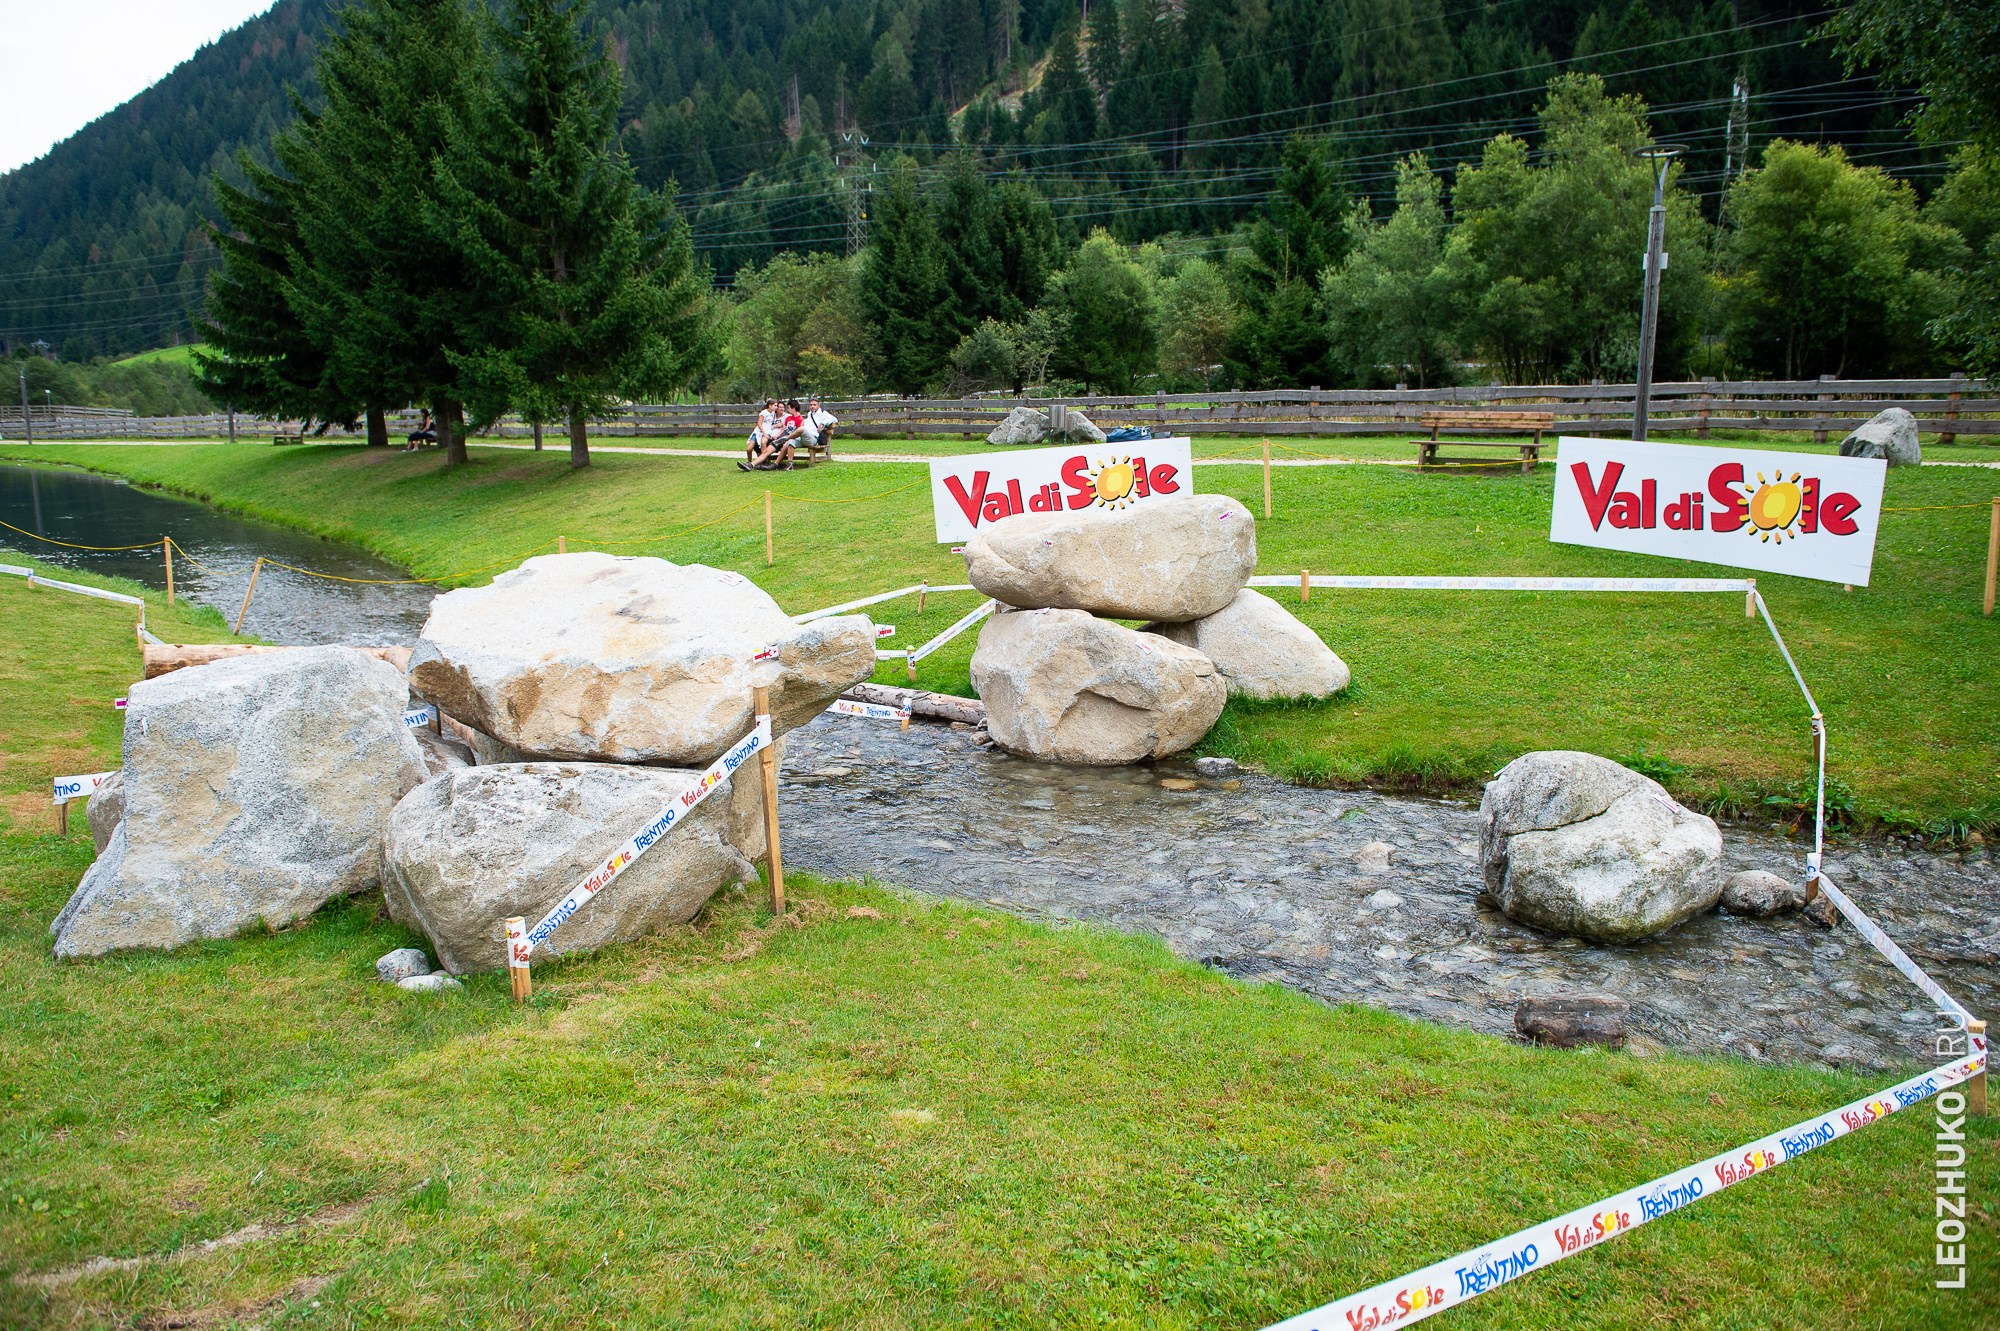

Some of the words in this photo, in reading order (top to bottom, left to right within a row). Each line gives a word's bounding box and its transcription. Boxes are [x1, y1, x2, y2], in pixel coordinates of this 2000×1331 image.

[943, 471, 1024, 528] Val
[1029, 482, 1063, 512] di
[1060, 455, 1180, 510] Sole
[1570, 461, 1657, 532] Val
[1663, 491, 1704, 531] di
[1707, 462, 1862, 543] Sole
[529, 899, 577, 945] TRENTINO
[584, 875, 602, 894] Val
[601, 872, 611, 884] di
[607, 851, 632, 877] Sole
[634, 809, 675, 851] TRENTINO
[681, 791, 697, 808] Val
[700, 770, 722, 792] Sole
[723, 736, 759, 772] TRENTINO
[1346, 1304, 1380, 1331] Val
[1395, 1284, 1445, 1320] Sole
[1455, 1243, 1539, 1298] TRENTINO
[1555, 1223, 1581, 1254] Val
[1582, 1225, 1595, 1246] di
[1592, 1207, 1631, 1241] Sole
[1637, 1176, 1703, 1222] TRENTINO
[1715, 1161, 1738, 1188] Val
[1738, 1162, 1748, 1178] di
[1744, 1149, 1776, 1176] Sole
[1779, 1121, 1835, 1161] TRENTINO
[1841, 1110, 1861, 1131] Val
[1868, 1099, 1893, 1122] Sole
